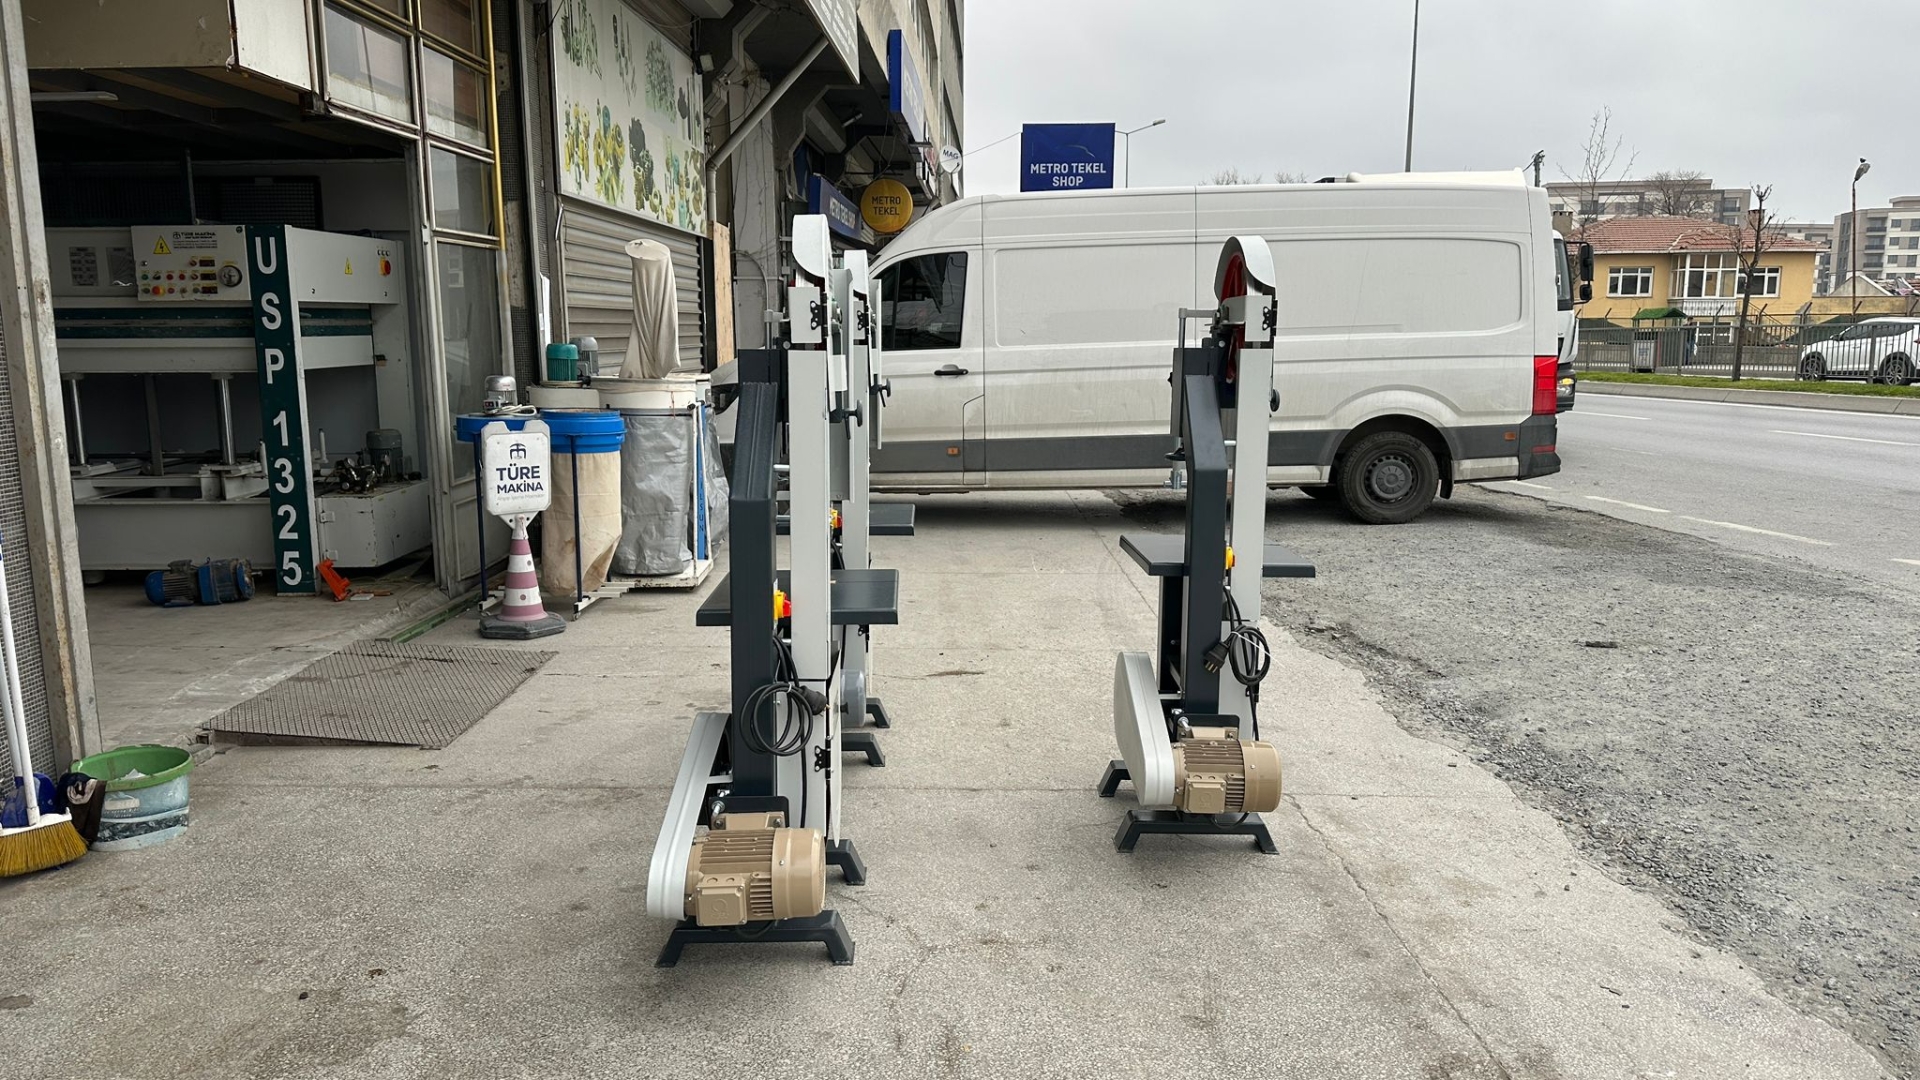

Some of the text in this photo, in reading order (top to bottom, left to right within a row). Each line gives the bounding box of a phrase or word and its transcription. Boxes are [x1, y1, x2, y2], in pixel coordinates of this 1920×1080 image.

[943, 149, 959, 159] MAG
[1030, 163, 1107, 174] METRO TEKEL
[1052, 176, 1084, 187] SHOP
[871, 196, 901, 205] METRO
[873, 206, 900, 216] TEKEL
[255, 236, 302, 586] USP 1325
[496, 463, 541, 481] TÜRE
[497, 480, 544, 494] MAKİNA
